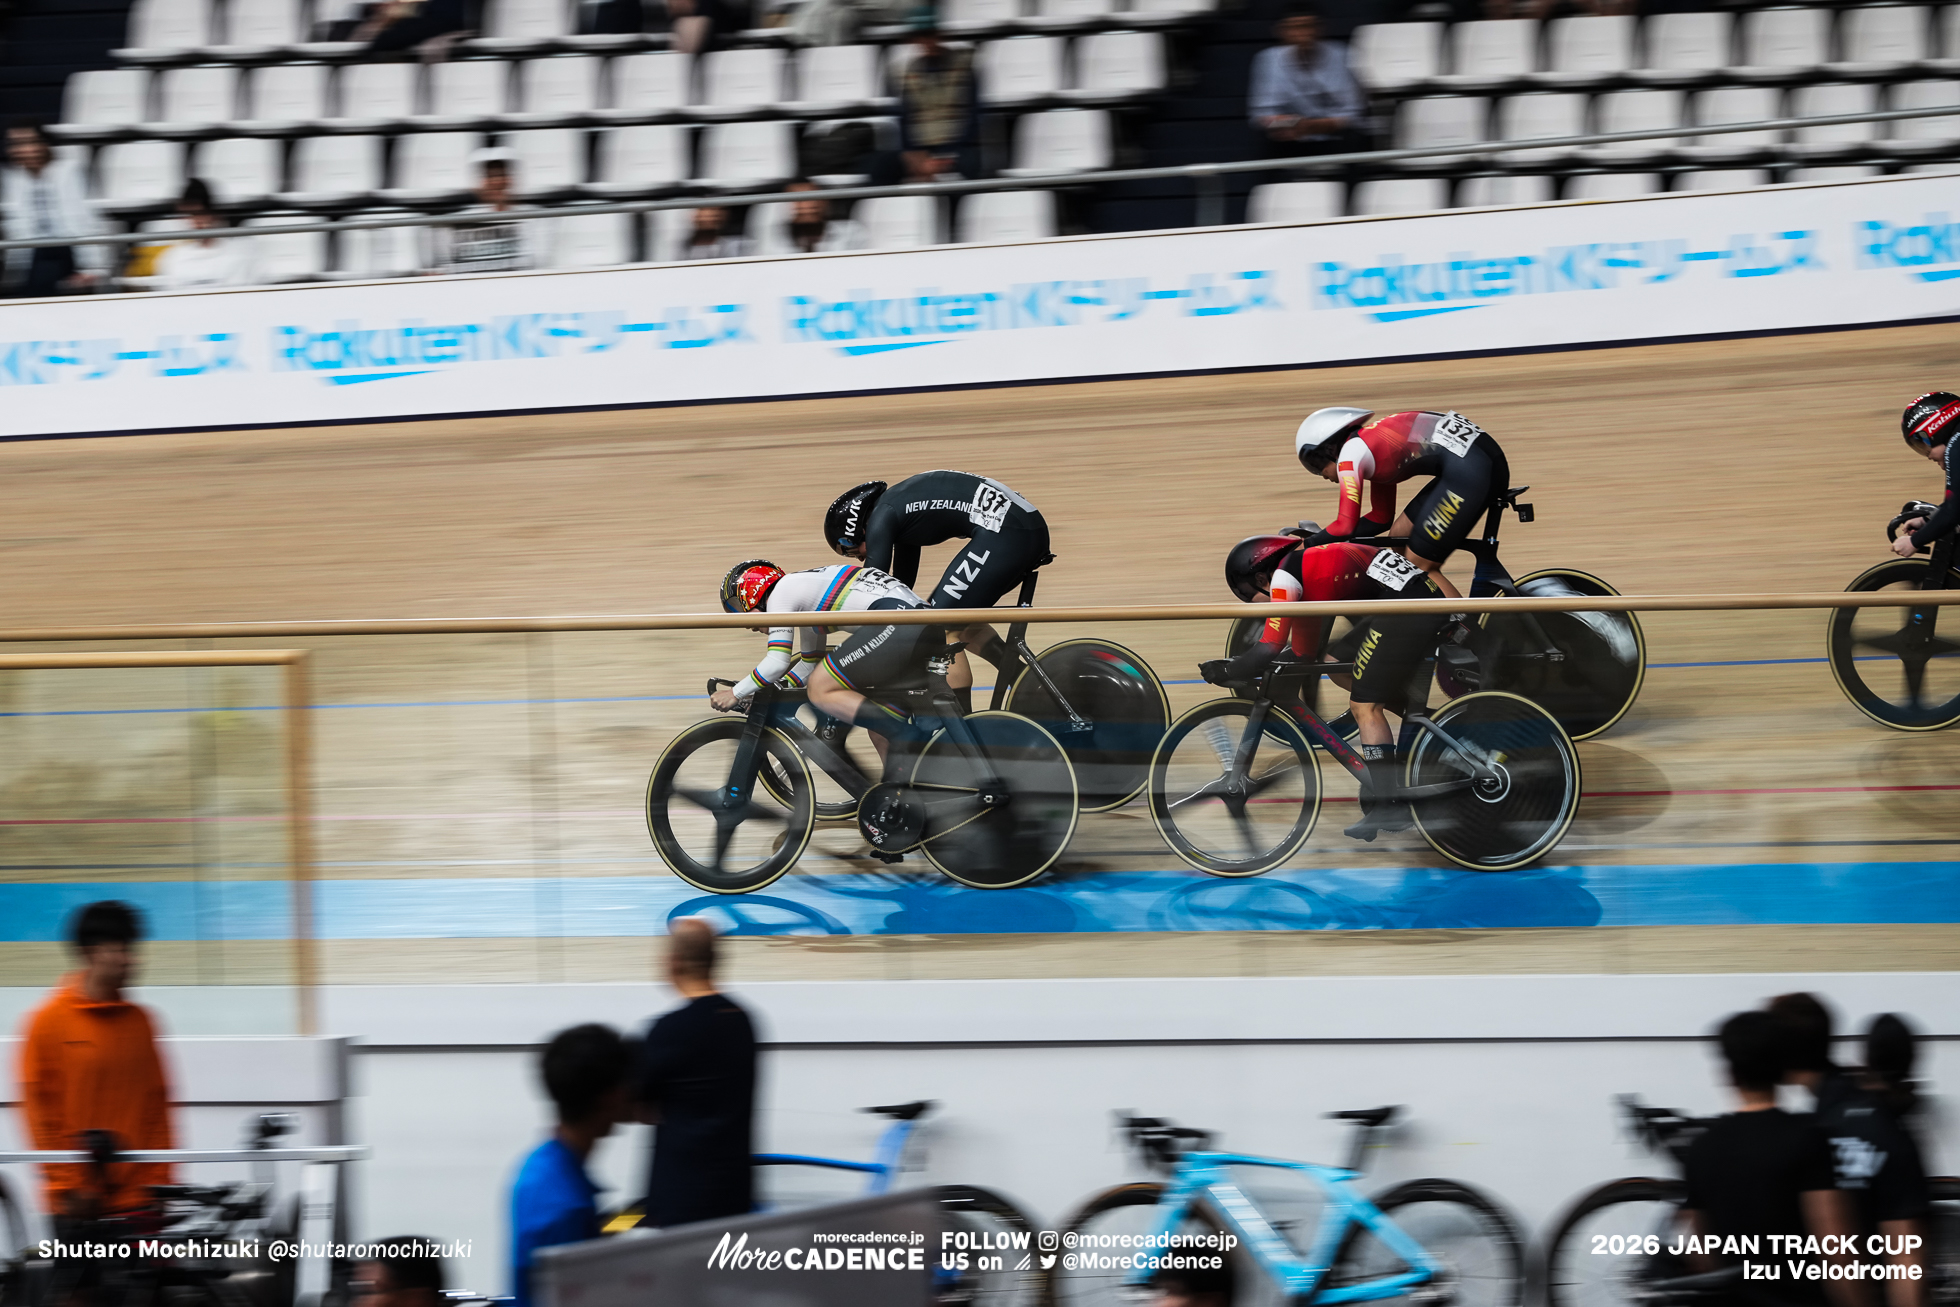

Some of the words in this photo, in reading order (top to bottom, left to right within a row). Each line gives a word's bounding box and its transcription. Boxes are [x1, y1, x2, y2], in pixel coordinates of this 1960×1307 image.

[1441, 419, 1474, 442] 132
[905, 500, 929, 514] NEW
[977, 487, 1009, 513] 137
[844, 499, 862, 537] KASK
[1423, 489, 1465, 541] CHINA
[942, 549, 991, 600] NZL
[1379, 552, 1413, 575] 133
[752, 569, 777, 597] JAPAN
[867, 624, 896, 650] RAKUTEN
[1352, 627, 1383, 680] CHINA
[1293, 706, 1348, 756] ARGON
[1348, 754, 1364, 771] 18
